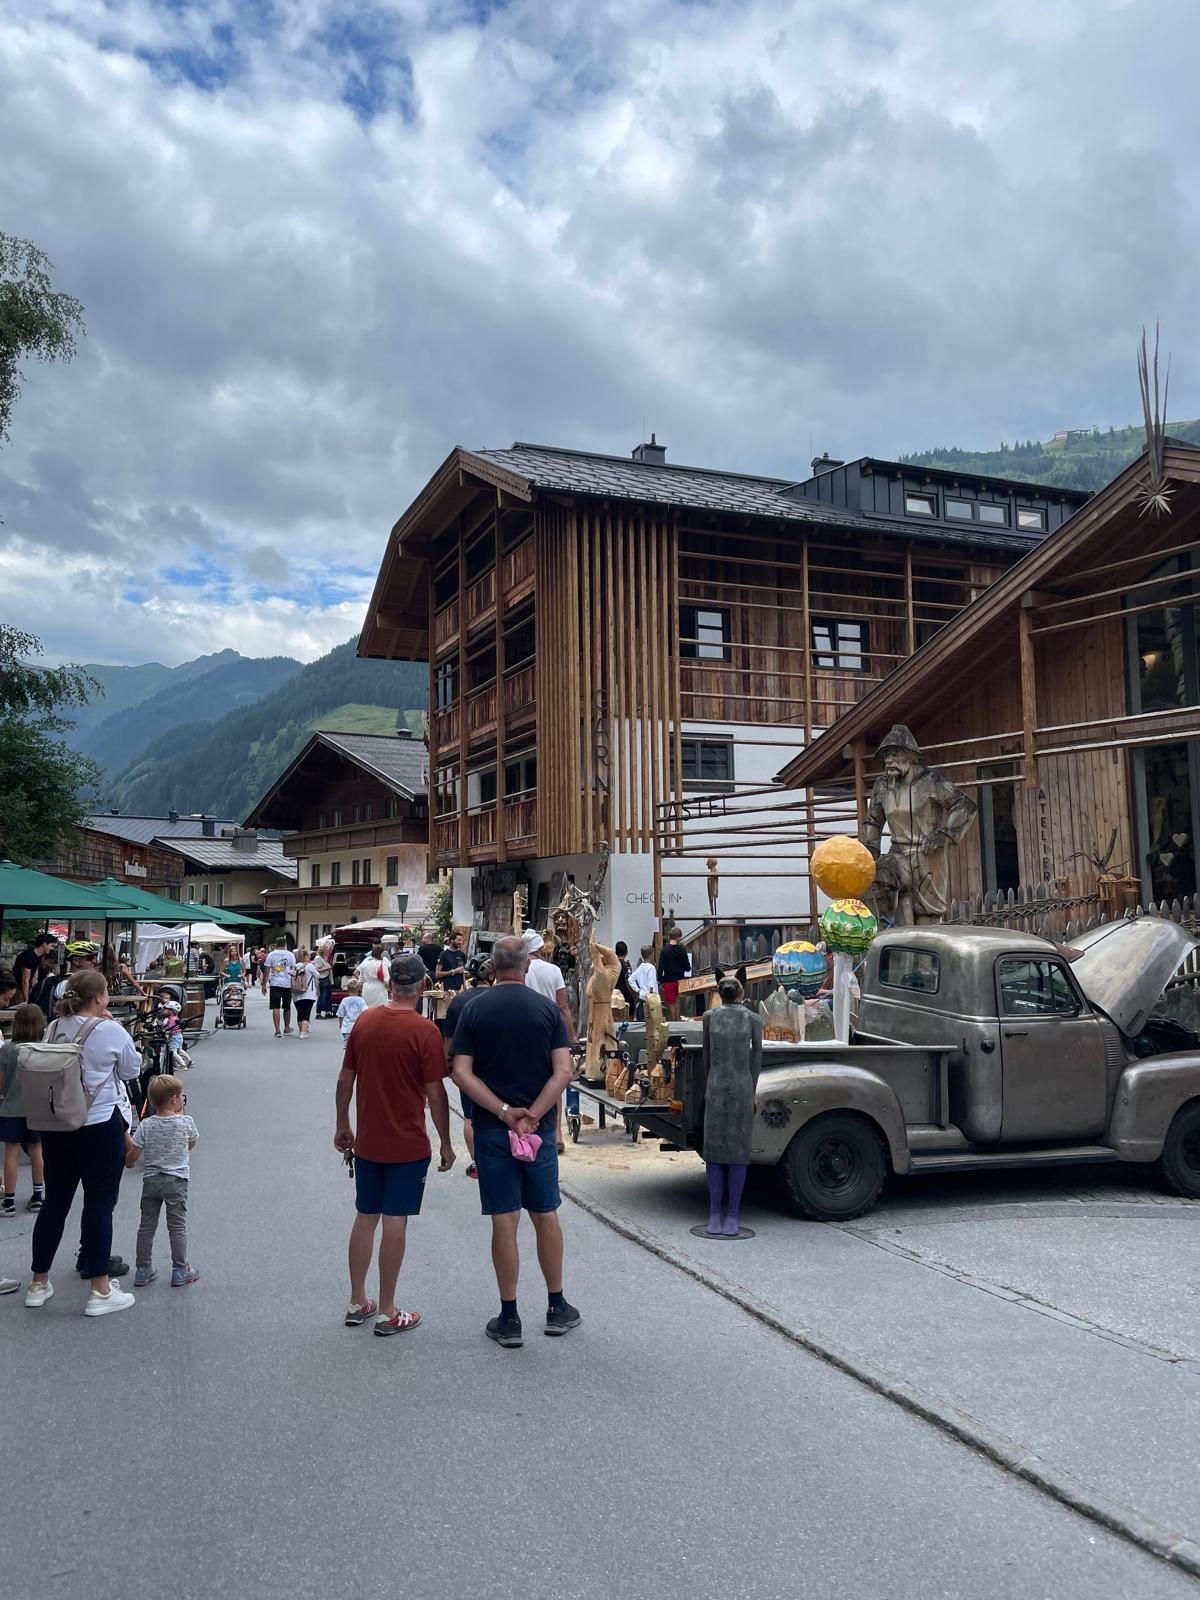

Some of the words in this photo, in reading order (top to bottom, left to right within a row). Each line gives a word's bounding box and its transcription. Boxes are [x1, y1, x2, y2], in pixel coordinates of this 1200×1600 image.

[1038, 789, 1051, 881] ATELIER
[626, 892, 666, 904] CHEC
[668, 892, 679, 904] IN
